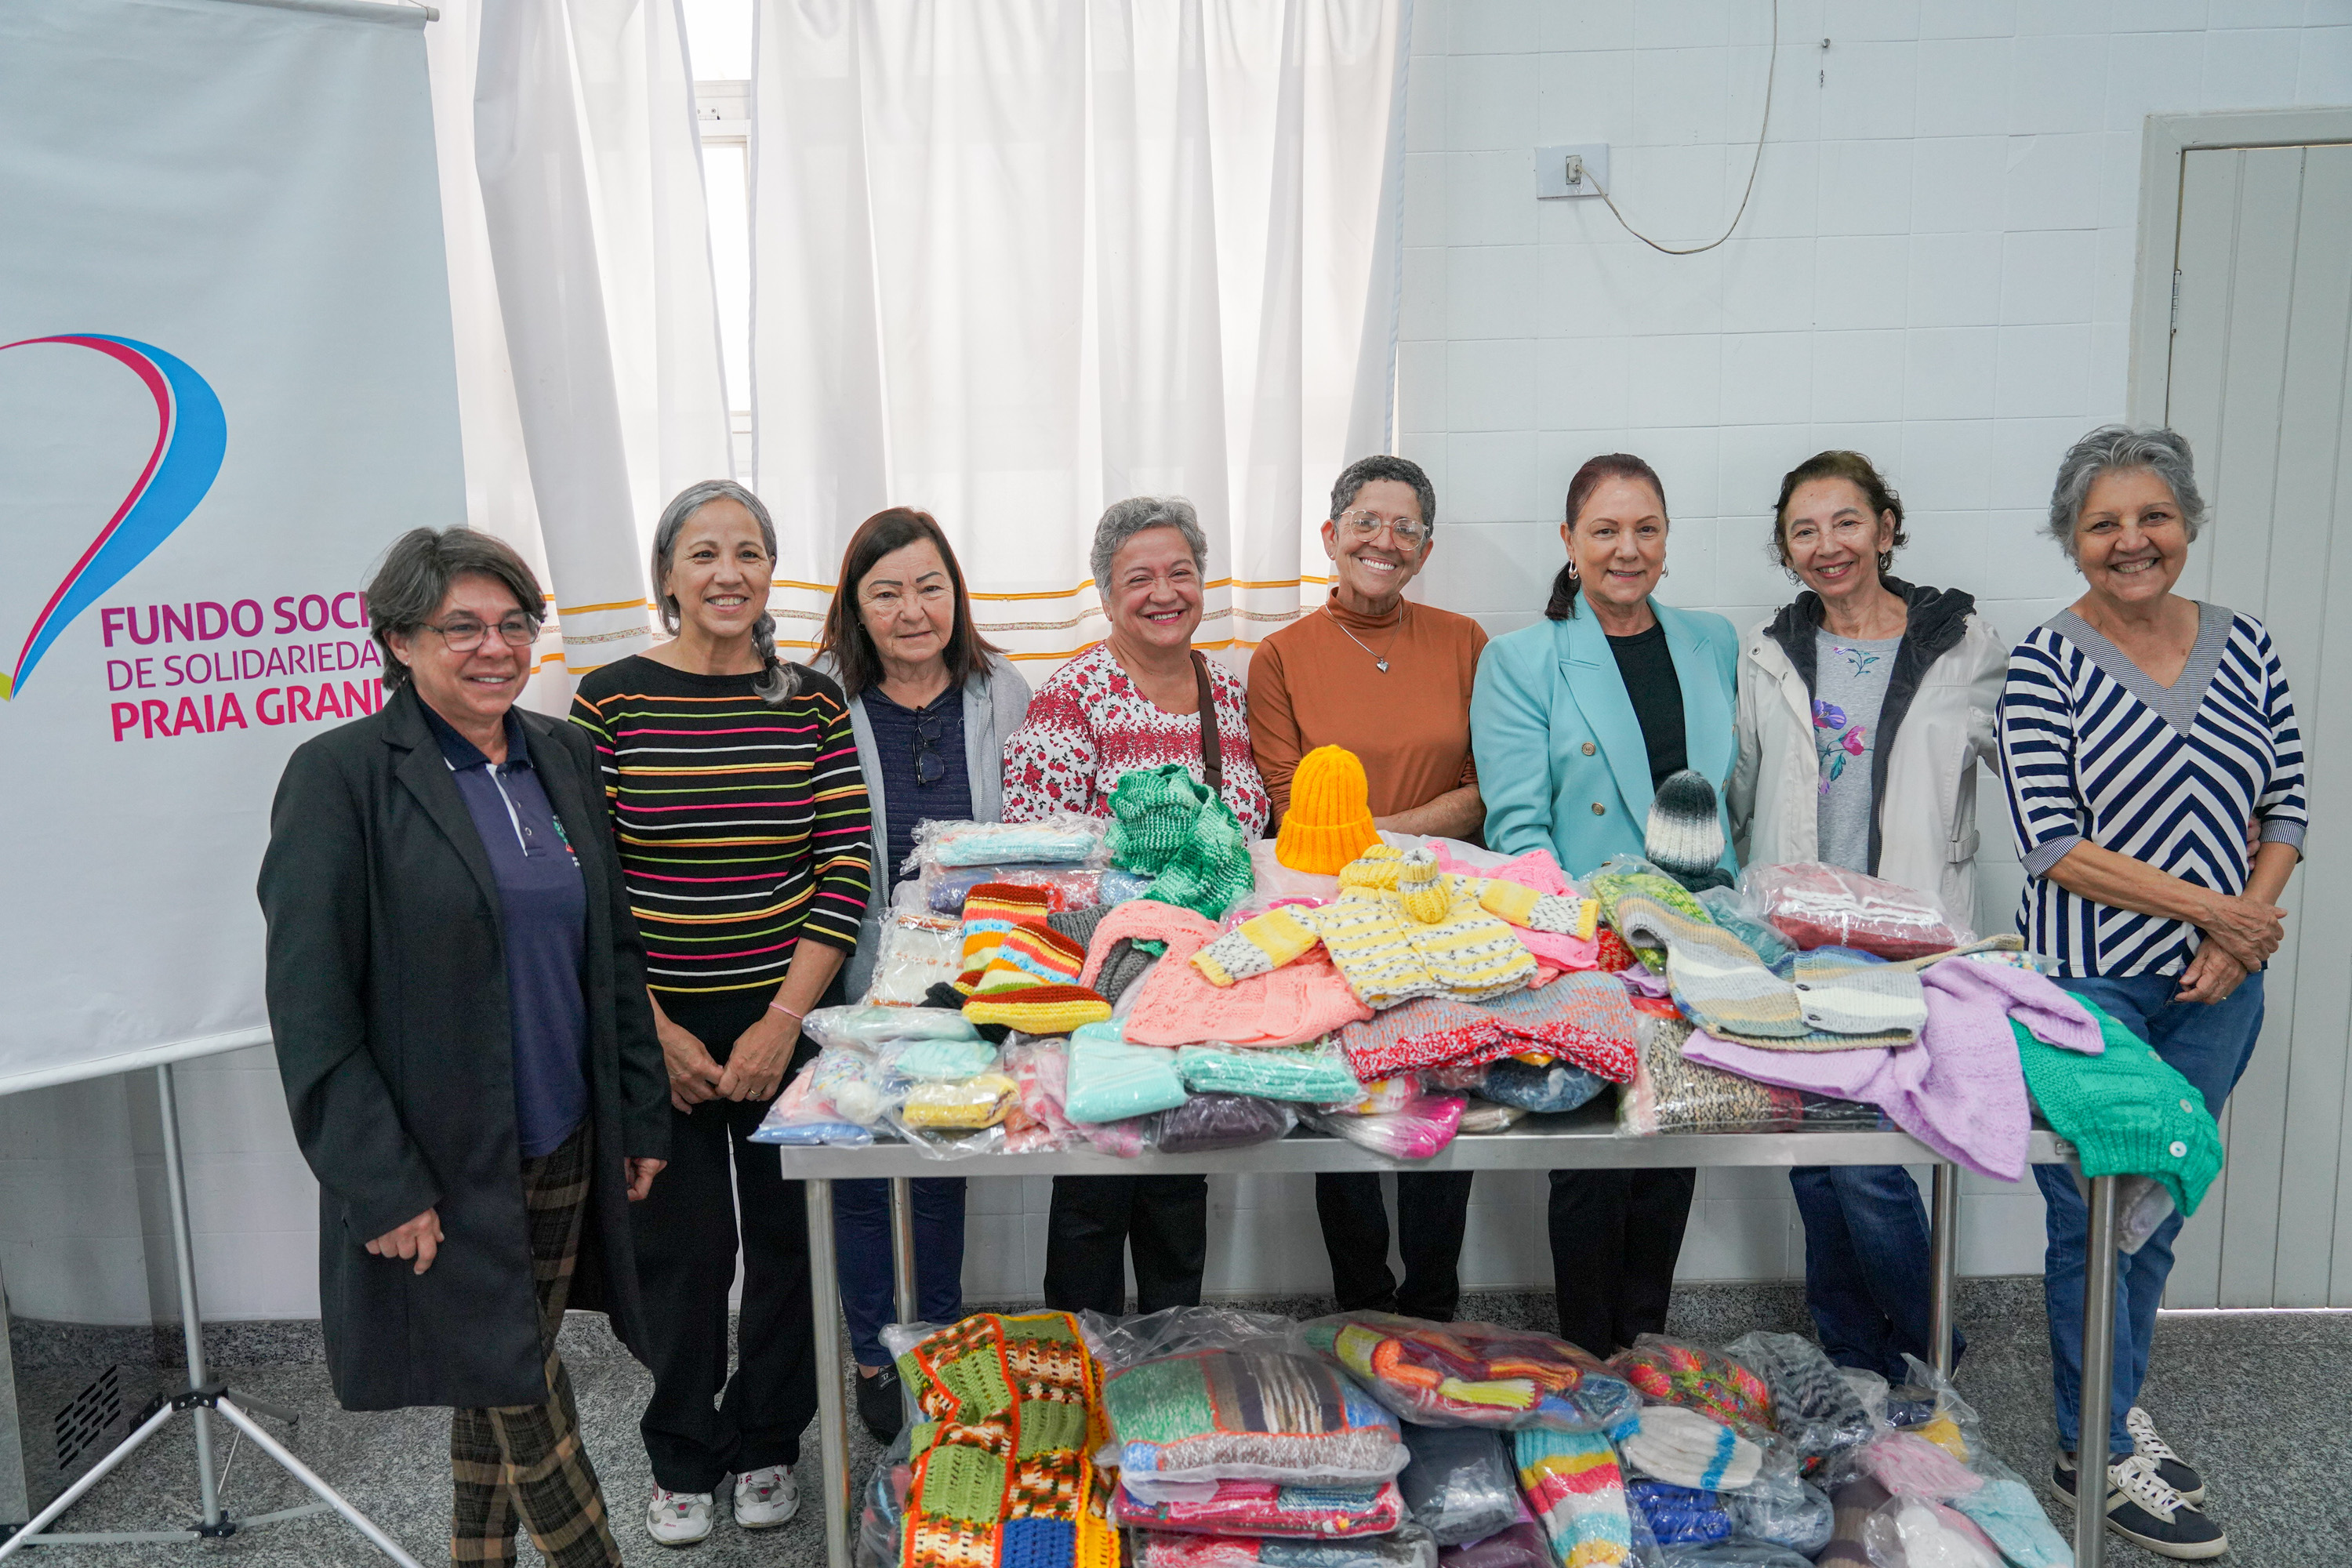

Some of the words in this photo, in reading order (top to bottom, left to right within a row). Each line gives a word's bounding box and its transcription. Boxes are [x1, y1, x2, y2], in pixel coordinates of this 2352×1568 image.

[101, 599, 263, 647] FUNDO
[107, 657, 156, 691] DE
[164, 639, 382, 686] SOLIDARIEDA
[111, 692, 249, 742] PRAIA
